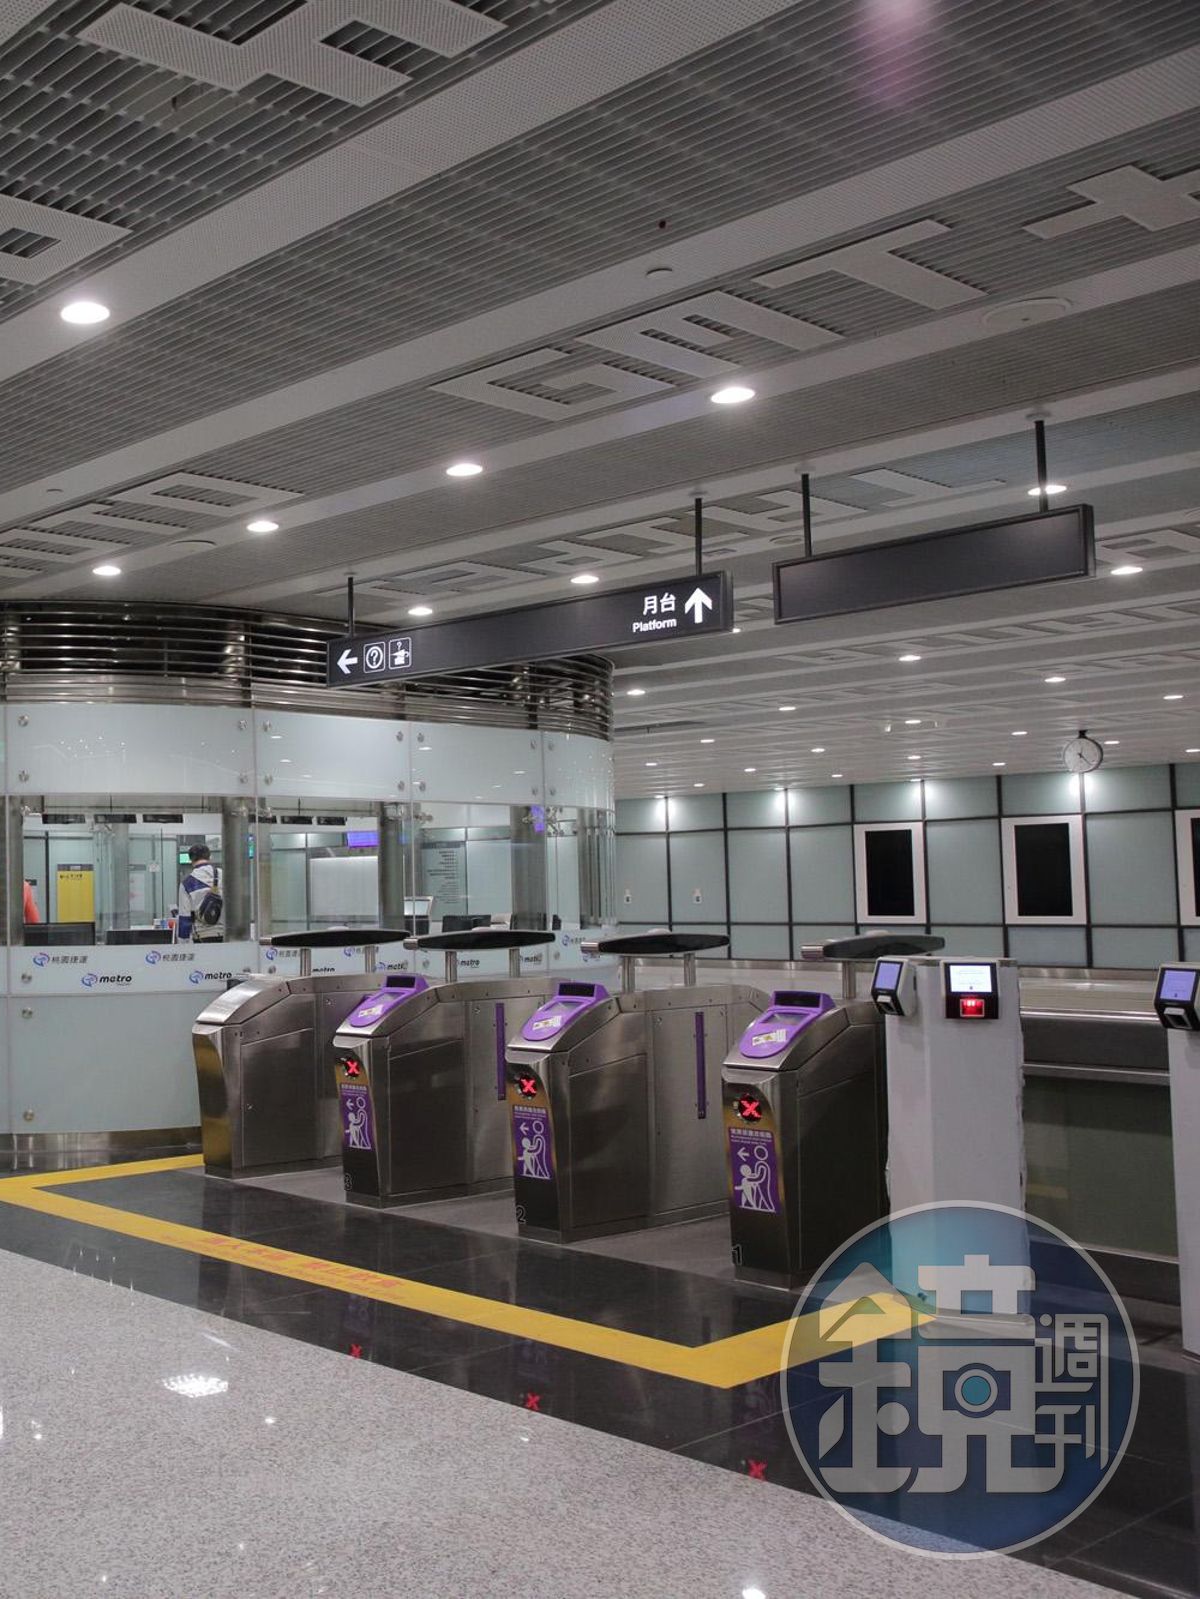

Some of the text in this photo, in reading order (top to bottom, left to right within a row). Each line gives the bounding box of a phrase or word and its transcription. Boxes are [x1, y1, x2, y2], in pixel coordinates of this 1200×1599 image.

[643, 592, 676, 615] 月台
[632, 619, 677, 632] Platform
[99, 974, 132, 983] metro
[204, 971, 232, 980] metro
[516, 1204, 526, 1225] 2
